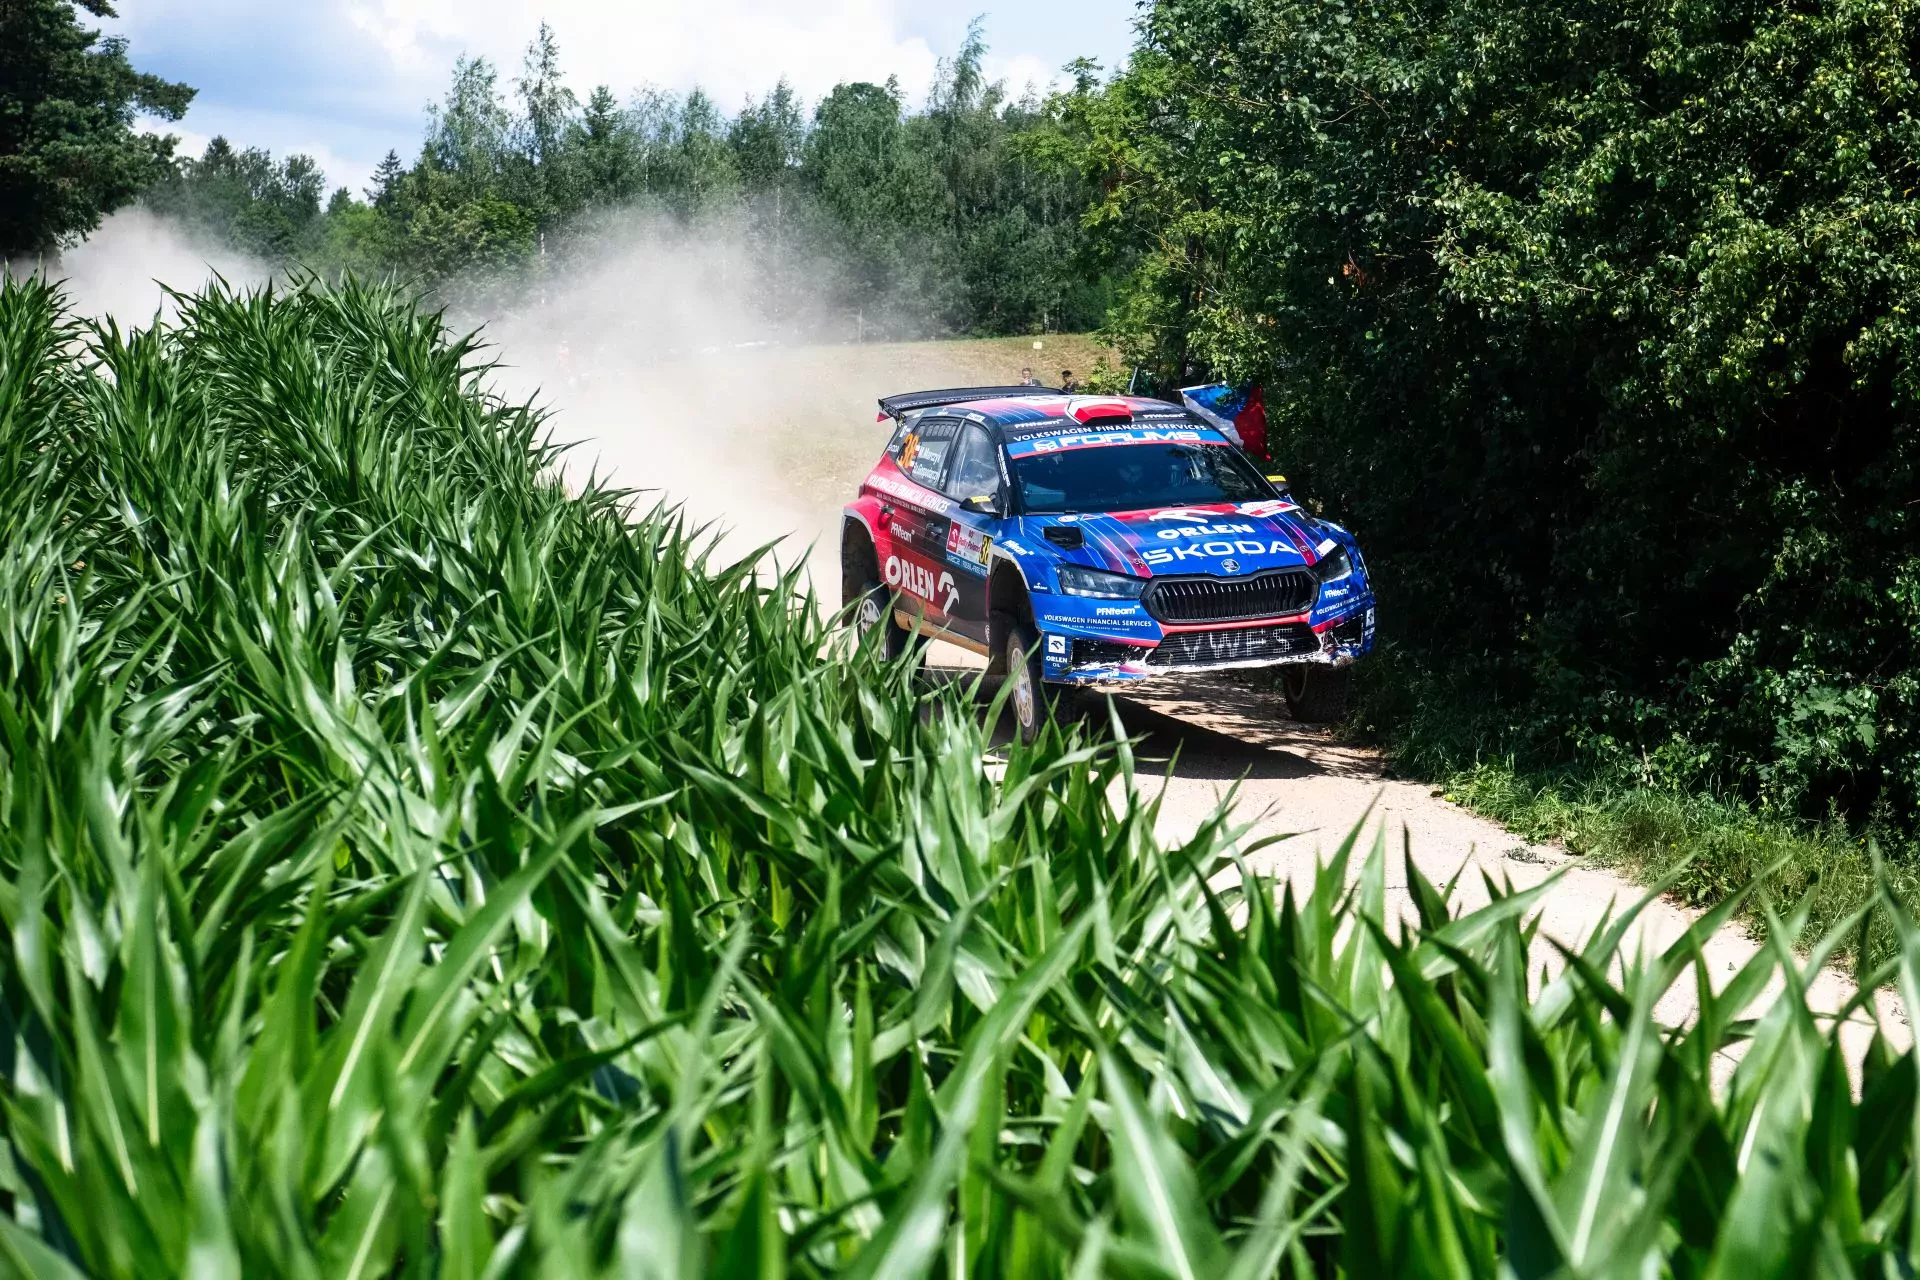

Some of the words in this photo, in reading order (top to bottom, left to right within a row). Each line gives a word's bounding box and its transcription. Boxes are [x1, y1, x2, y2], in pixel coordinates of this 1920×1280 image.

[1013, 426, 1093, 442] VOLKSWAGEN
[1096, 423, 1154, 432] FINANCIAL
[1157, 423, 1208, 431] SERVICES
[895, 484, 926, 504] FINANCIAL
[922, 494, 952, 514] SERVICES
[1156, 523, 1256, 540] ORLEN
[979, 535, 992, 566] 38
[884, 555, 935, 602] ORLEN
[1044, 614, 1086, 624] VOLKSWAGEN
[1086, 618, 1120, 626] FINANCIAL
[1096, 607, 1136, 616] PFNteam
[1046, 656, 1068, 664] ORLEN
